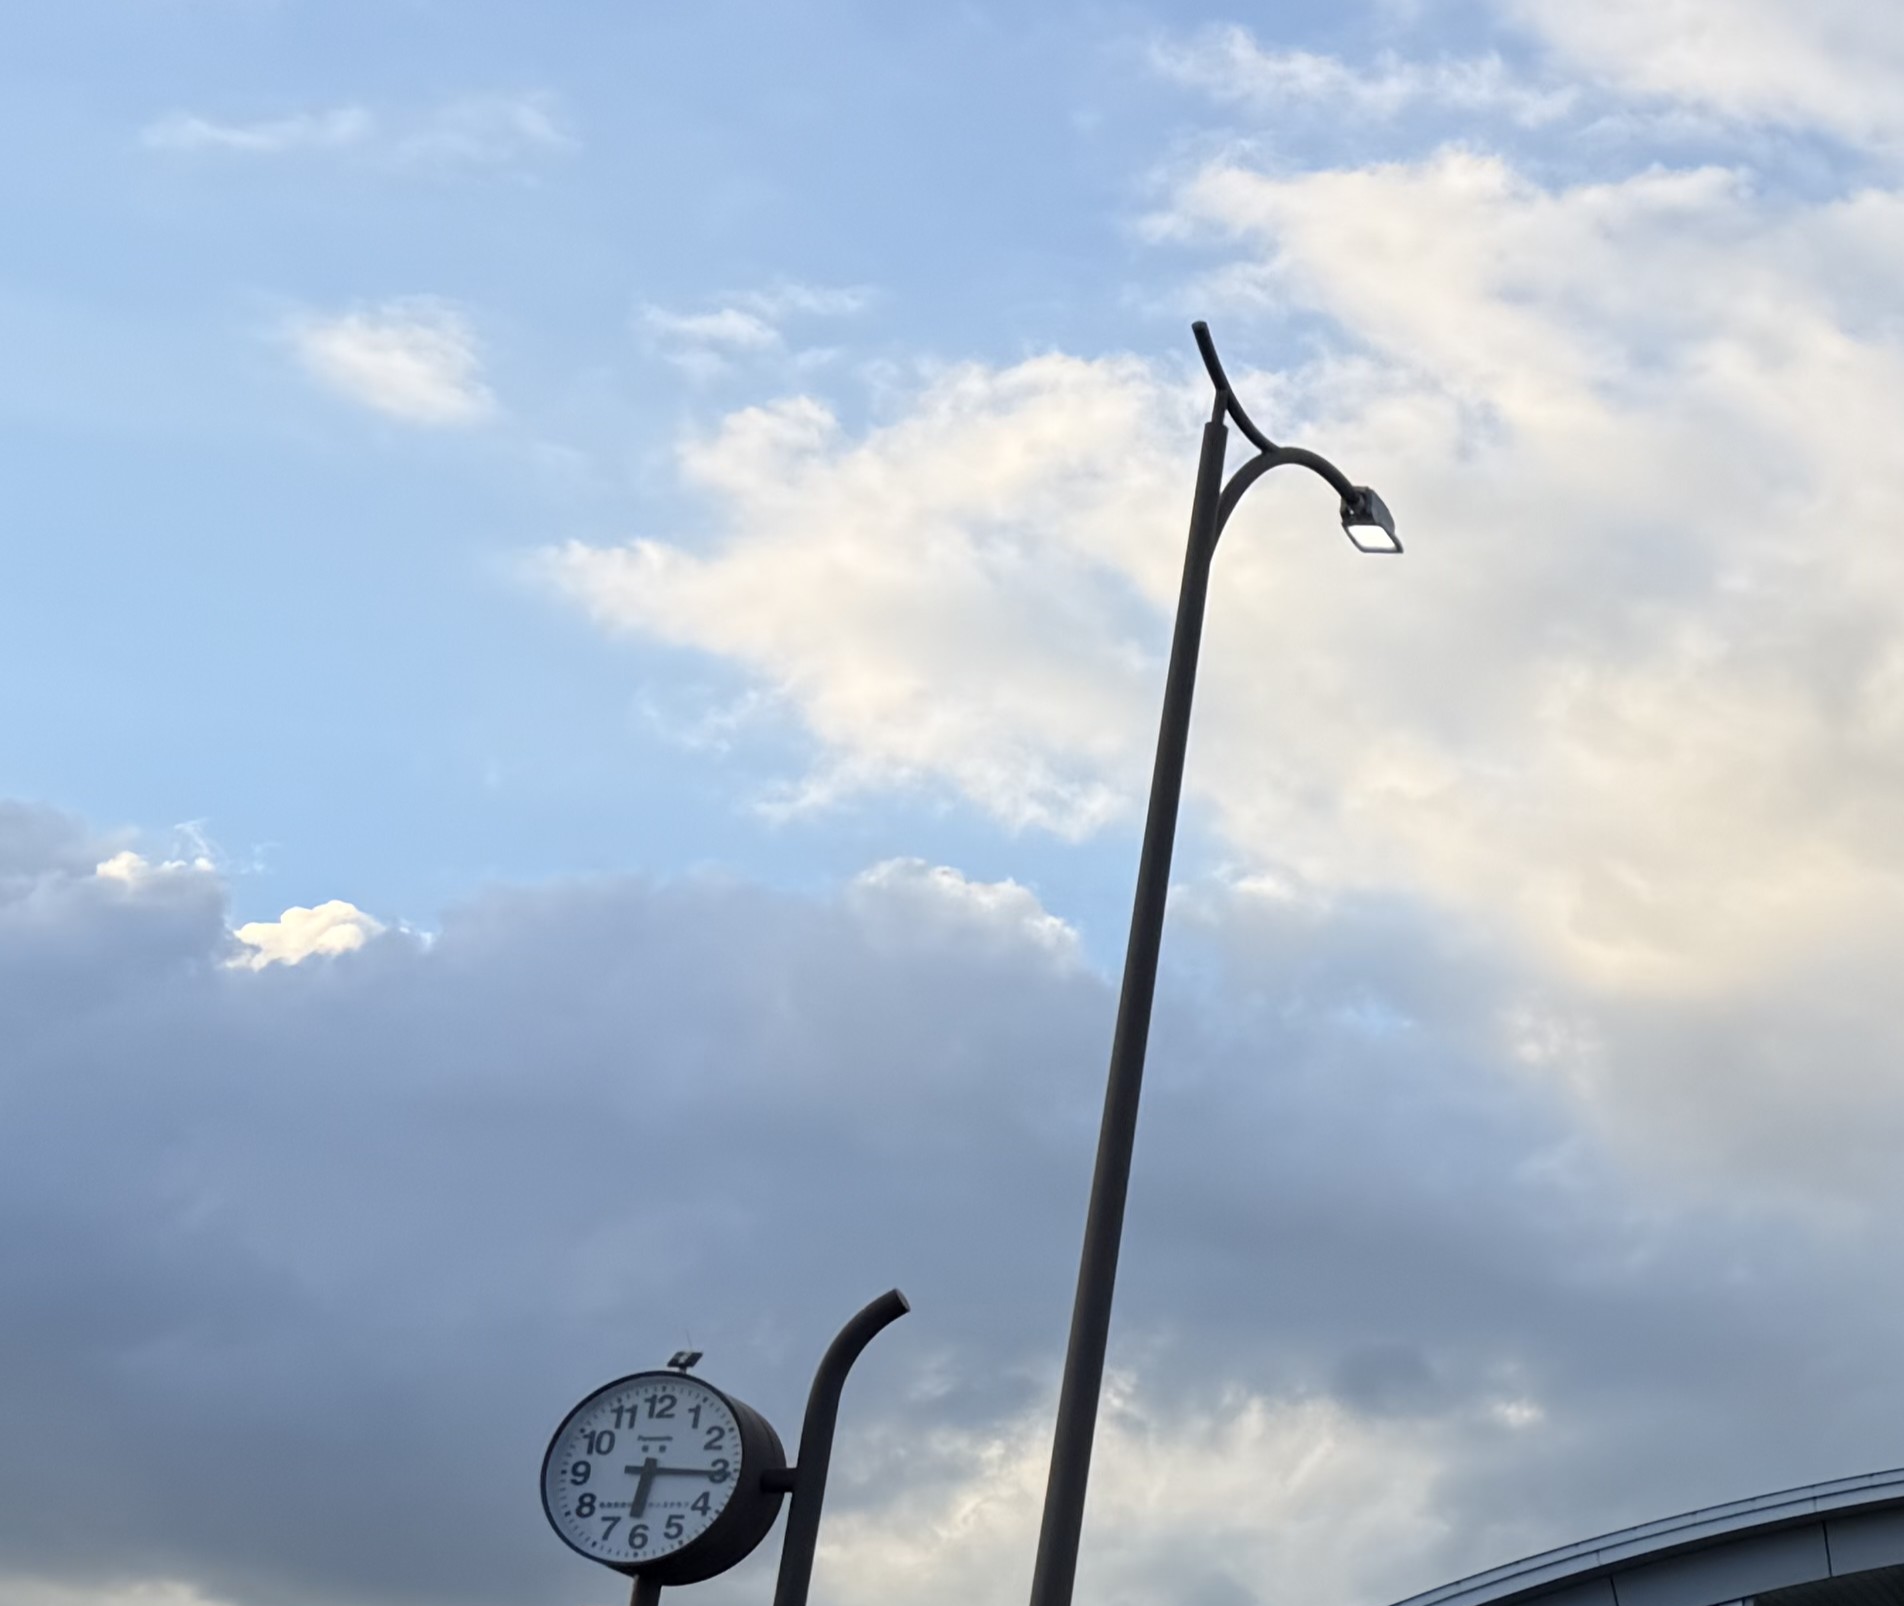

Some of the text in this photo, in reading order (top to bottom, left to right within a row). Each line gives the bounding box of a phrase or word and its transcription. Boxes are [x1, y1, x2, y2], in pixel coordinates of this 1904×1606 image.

[611, 1404, 638, 1429] 11
[644, 1394, 678, 1419] 12
[688, 1404, 702, 1429] 1
[583, 1430, 615, 1455] 10
[703, 1426, 726, 1451] 2
[570, 1460, 592, 1486] 9
[708, 1459, 730, 1484] 3
[575, 1493, 597, 1518] 8
[690, 1491, 712, 1517] 4
[600, 1516, 622, 1541] 7
[628, 1524, 649, 1549] 6
[663, 1514, 685, 1540] 5
